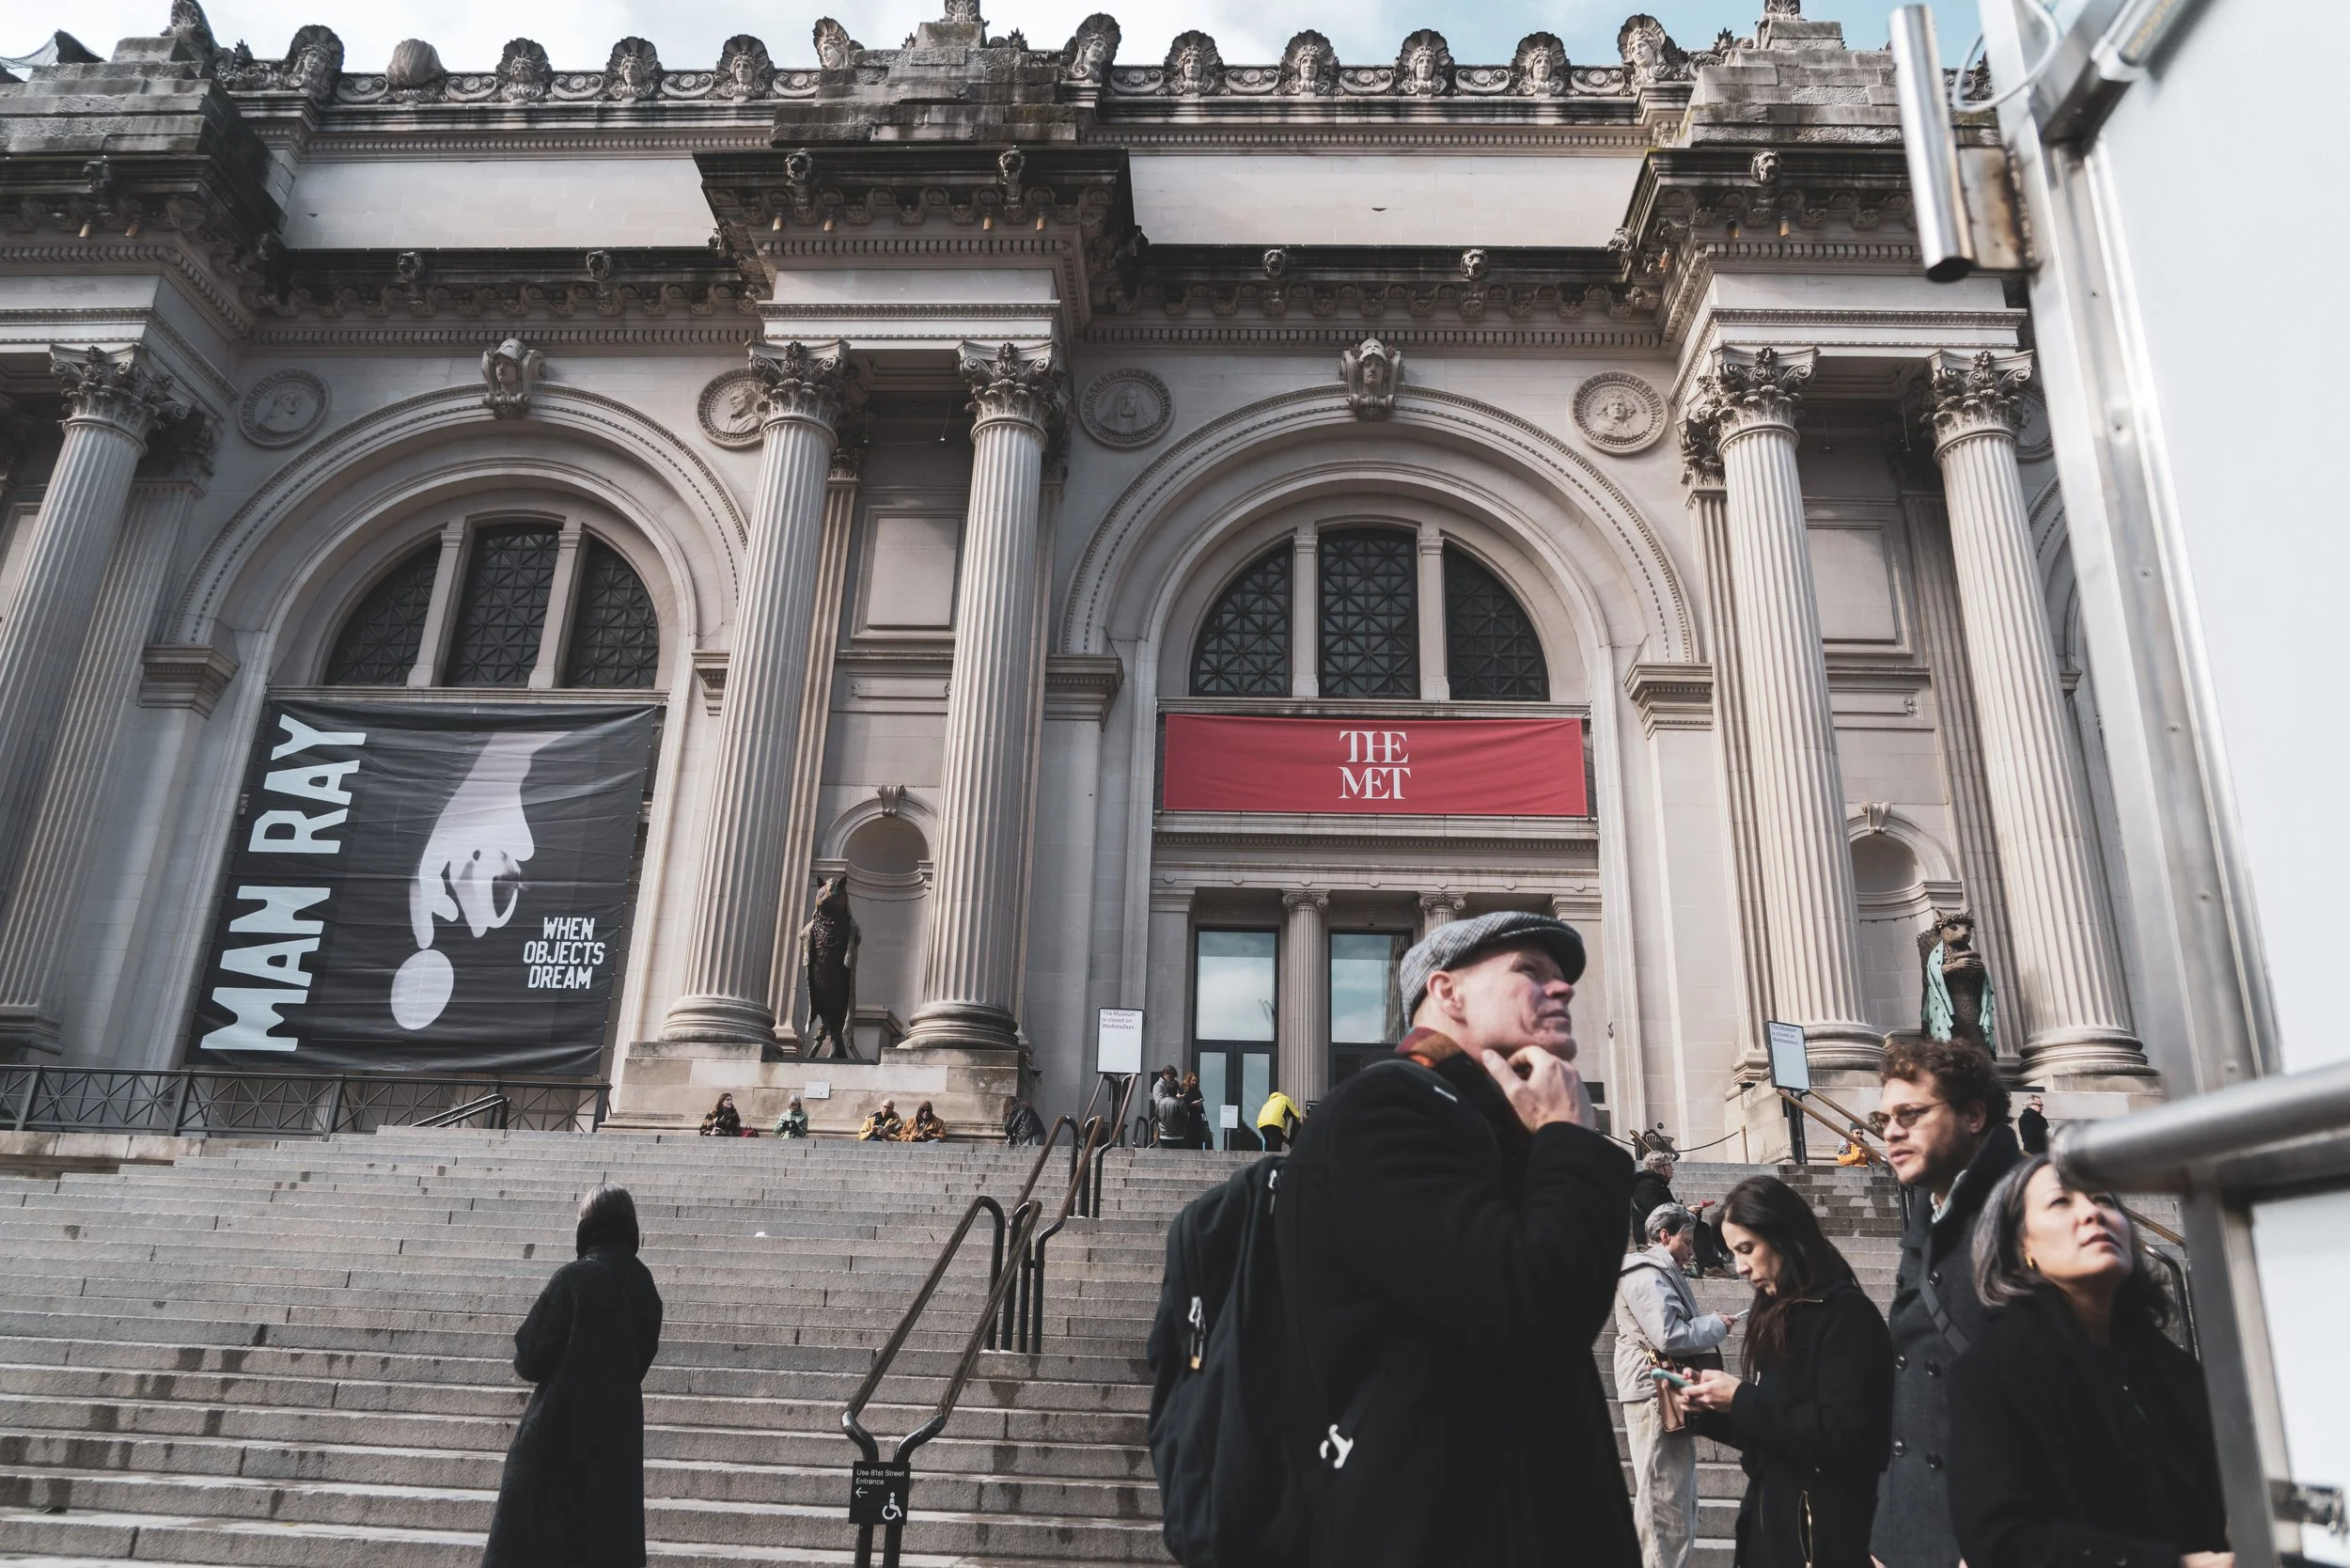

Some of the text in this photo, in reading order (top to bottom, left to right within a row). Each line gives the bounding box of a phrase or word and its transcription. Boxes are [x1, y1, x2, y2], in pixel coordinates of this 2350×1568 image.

[1339, 730, 1409, 763] THE
[1338, 766, 1411, 800] MET
[200, 714, 367, 1052] MAN RAY
[543, 917, 595, 941] WHEN
[523, 941, 606, 965] OBJECTS
[527, 965, 593, 990] DREAM
